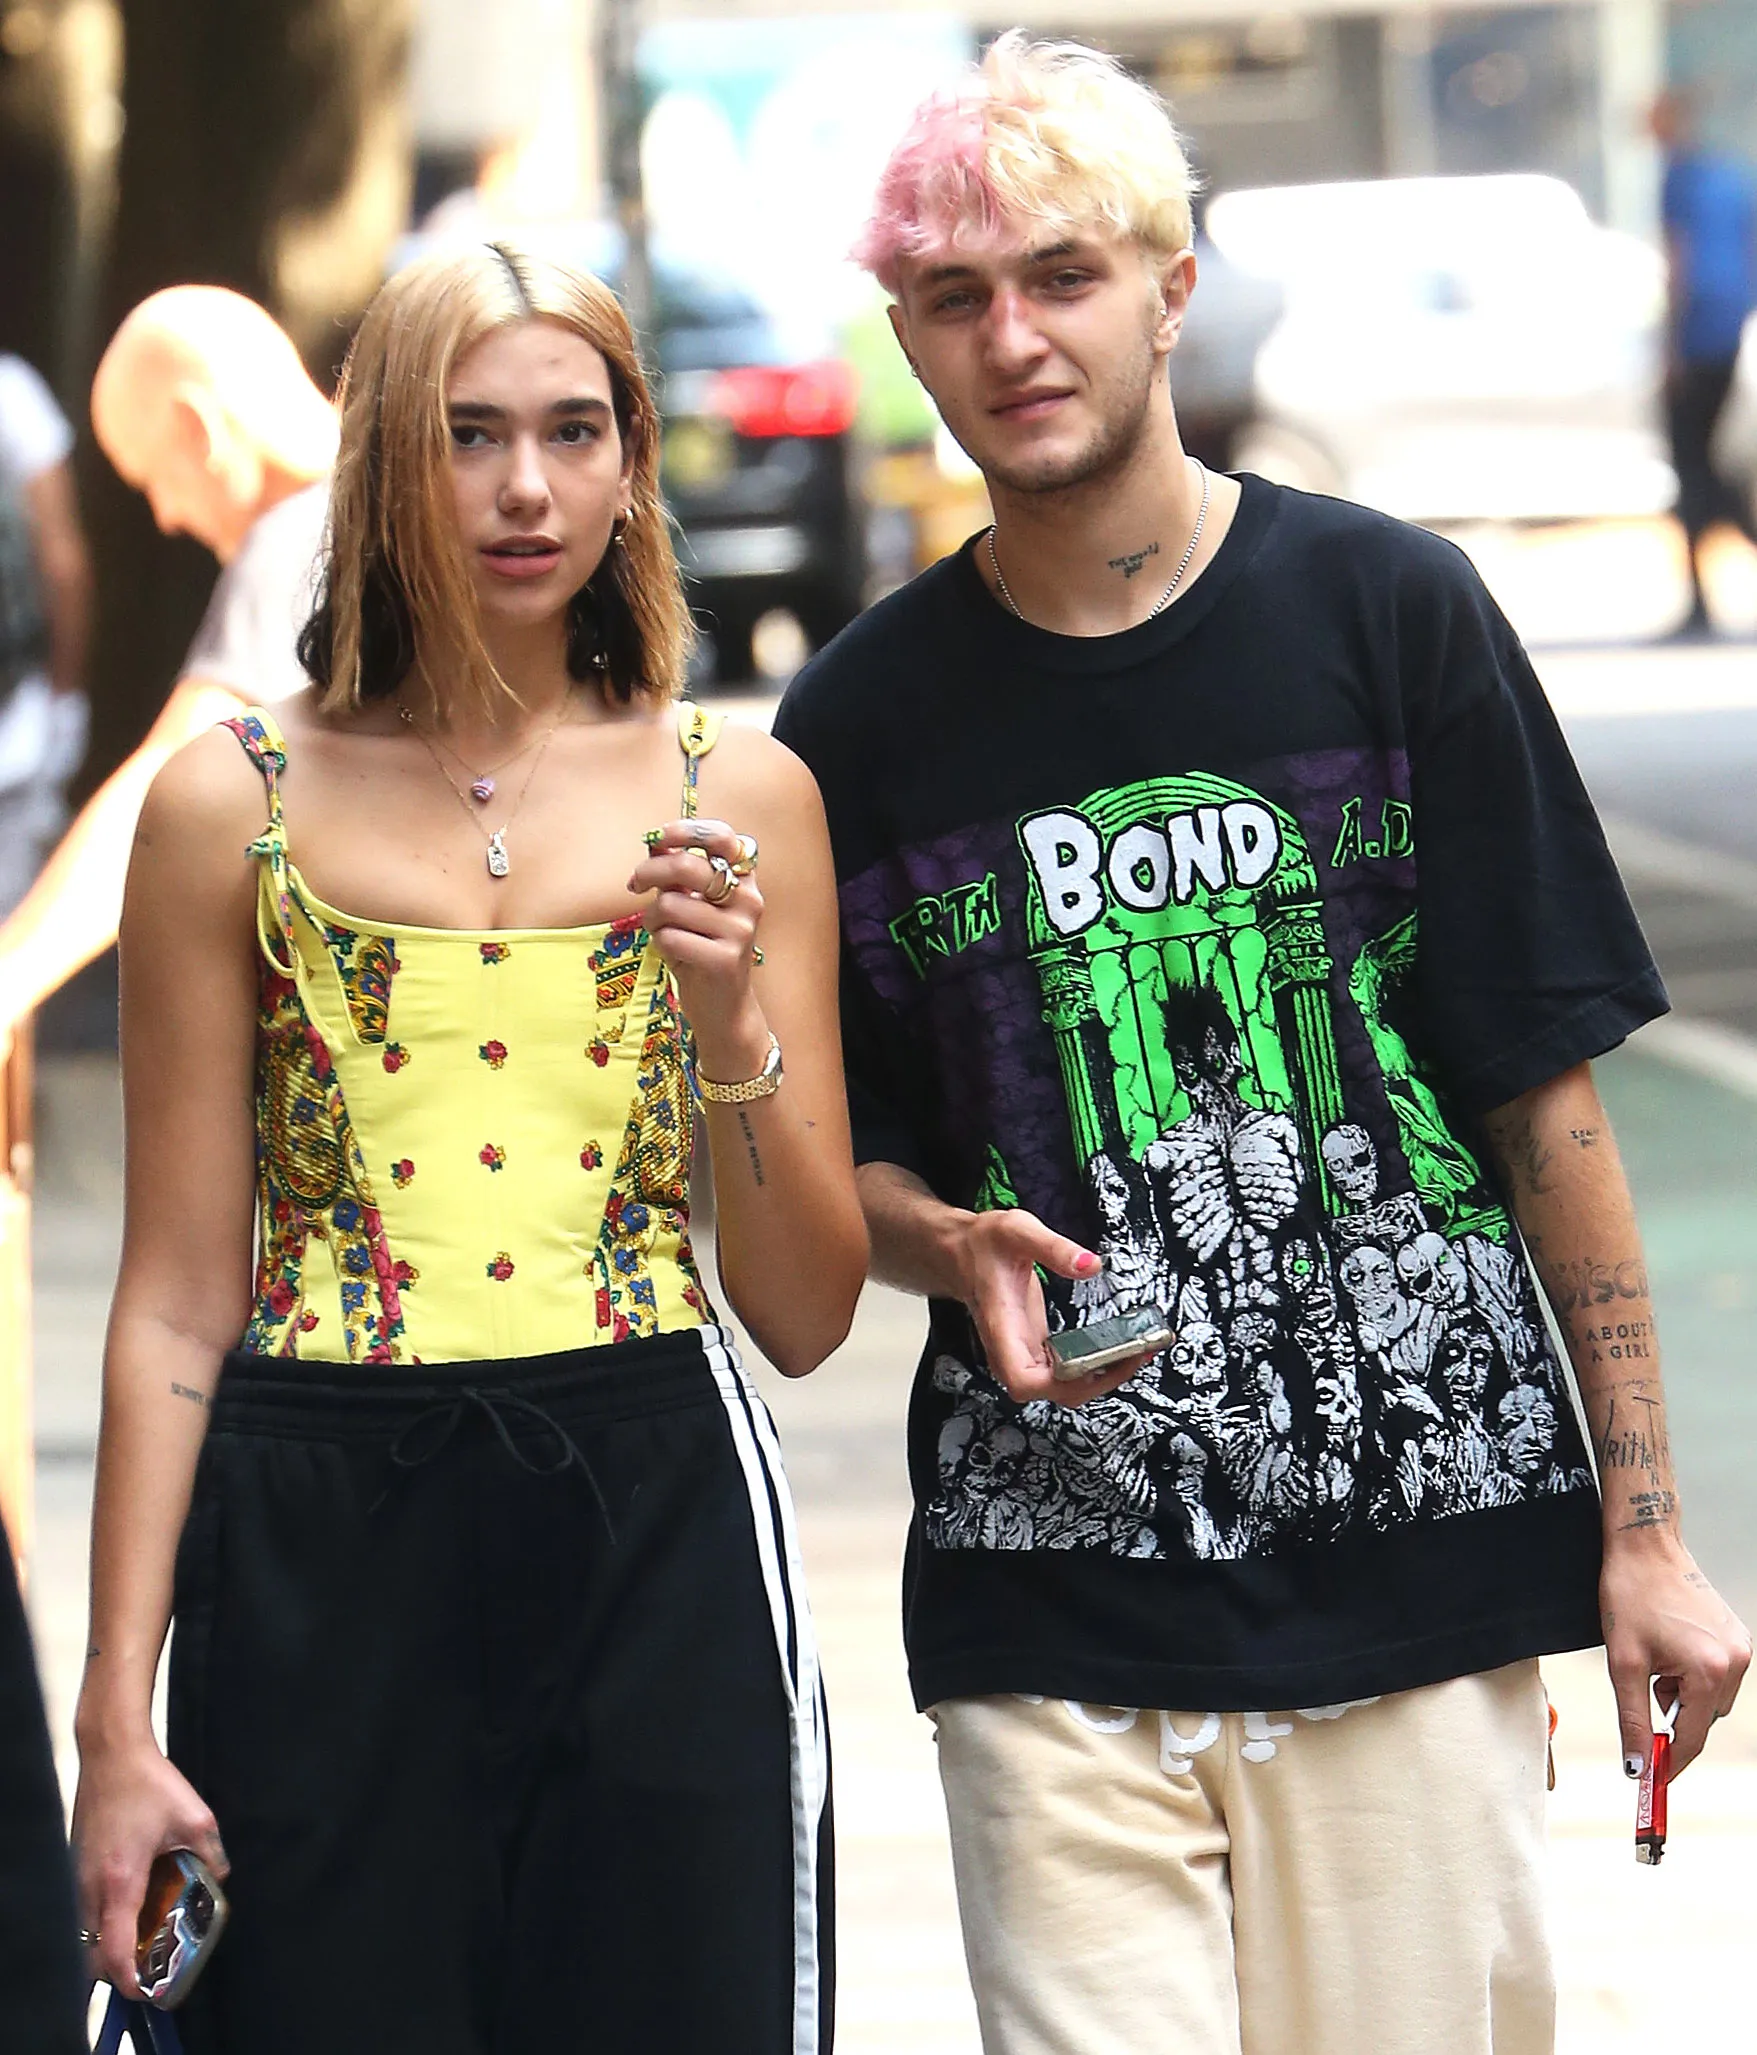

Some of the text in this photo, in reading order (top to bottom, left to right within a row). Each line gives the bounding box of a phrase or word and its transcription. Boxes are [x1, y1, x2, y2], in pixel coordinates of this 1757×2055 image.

[1018, 801, 1281, 937] BOND
[1586, 1321, 1647, 1343] ABOUT
[1591, 1343, 1650, 1363] A GIRL
